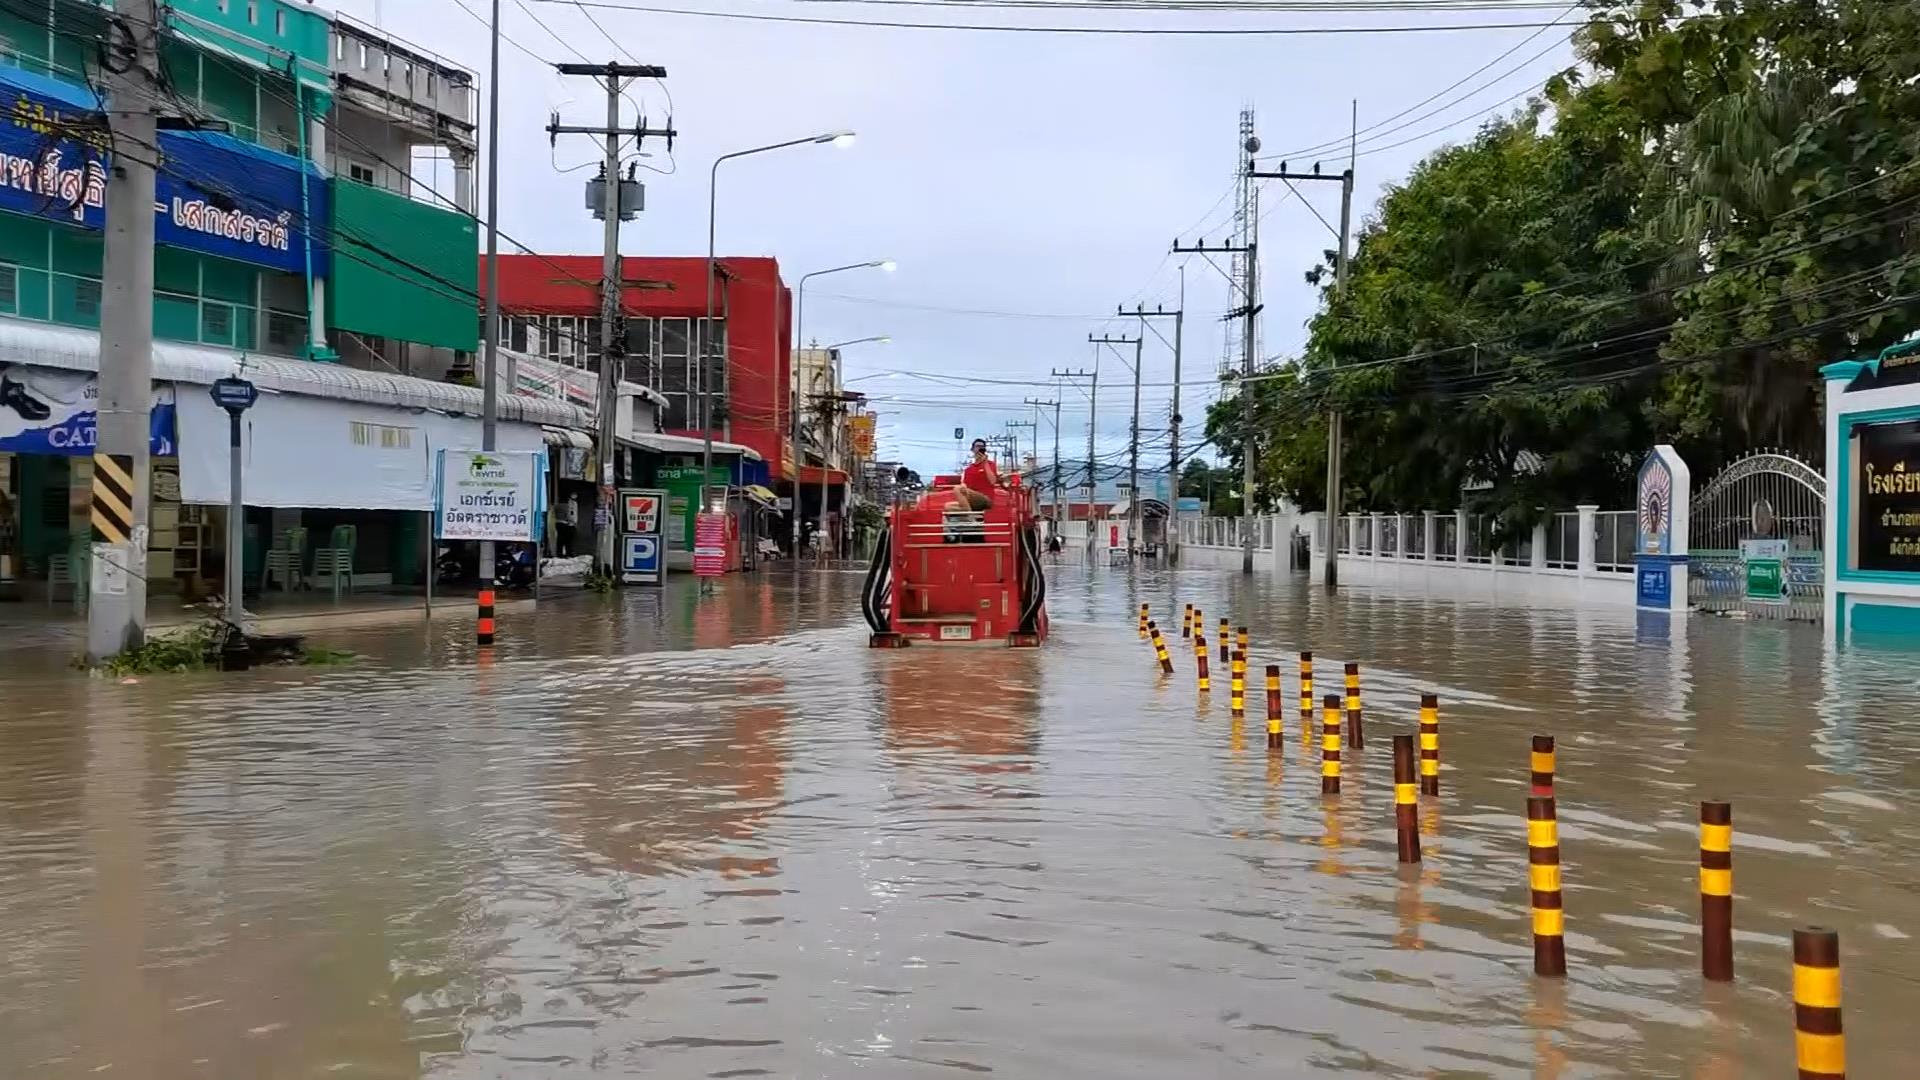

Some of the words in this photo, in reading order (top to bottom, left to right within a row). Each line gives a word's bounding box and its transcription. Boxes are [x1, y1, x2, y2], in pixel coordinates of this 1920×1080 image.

[172, 197, 291, 250] เสกสรรค์
[626, 538, 655, 567] P
